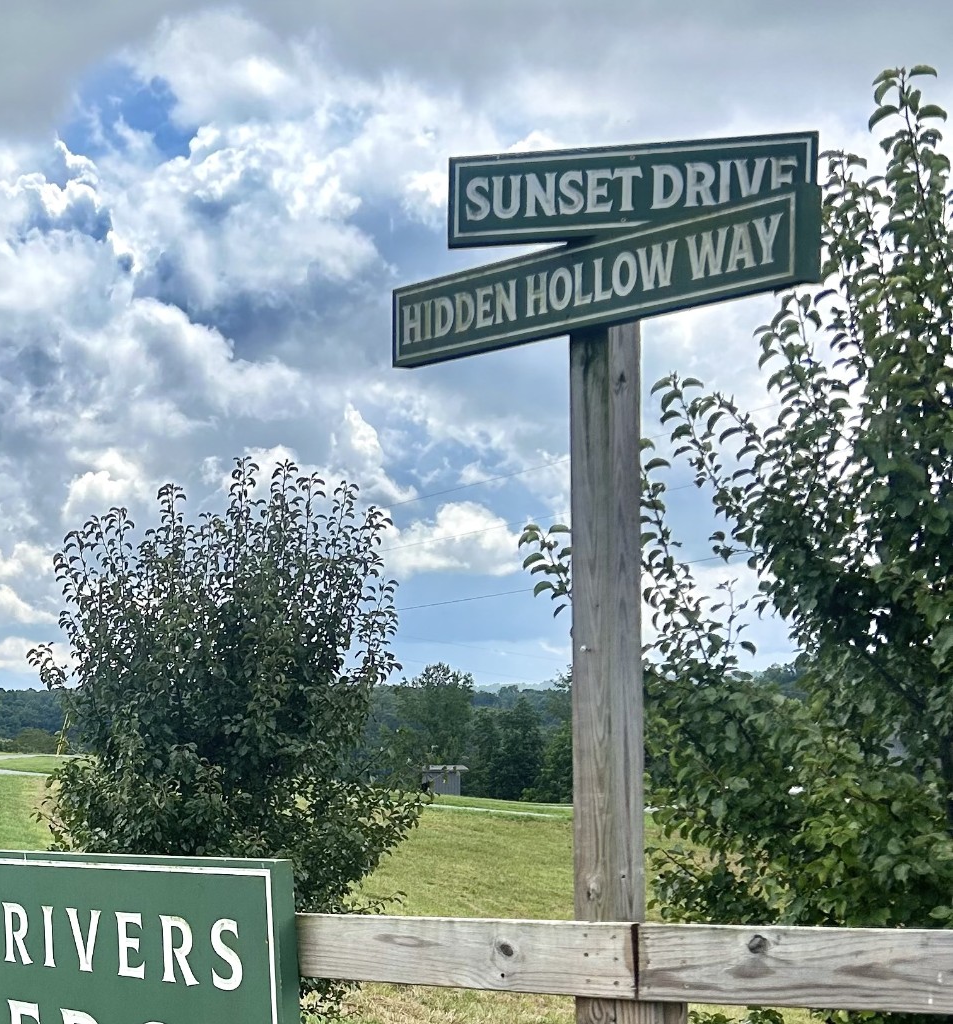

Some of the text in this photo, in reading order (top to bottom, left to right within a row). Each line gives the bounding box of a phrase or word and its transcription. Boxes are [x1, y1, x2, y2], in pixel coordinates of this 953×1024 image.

[466, 166, 643, 222] SUNSET
[402, 212, 784, 346] HIDDEN HOLLOW WAY
[1, 901, 244, 992] RIVERS
